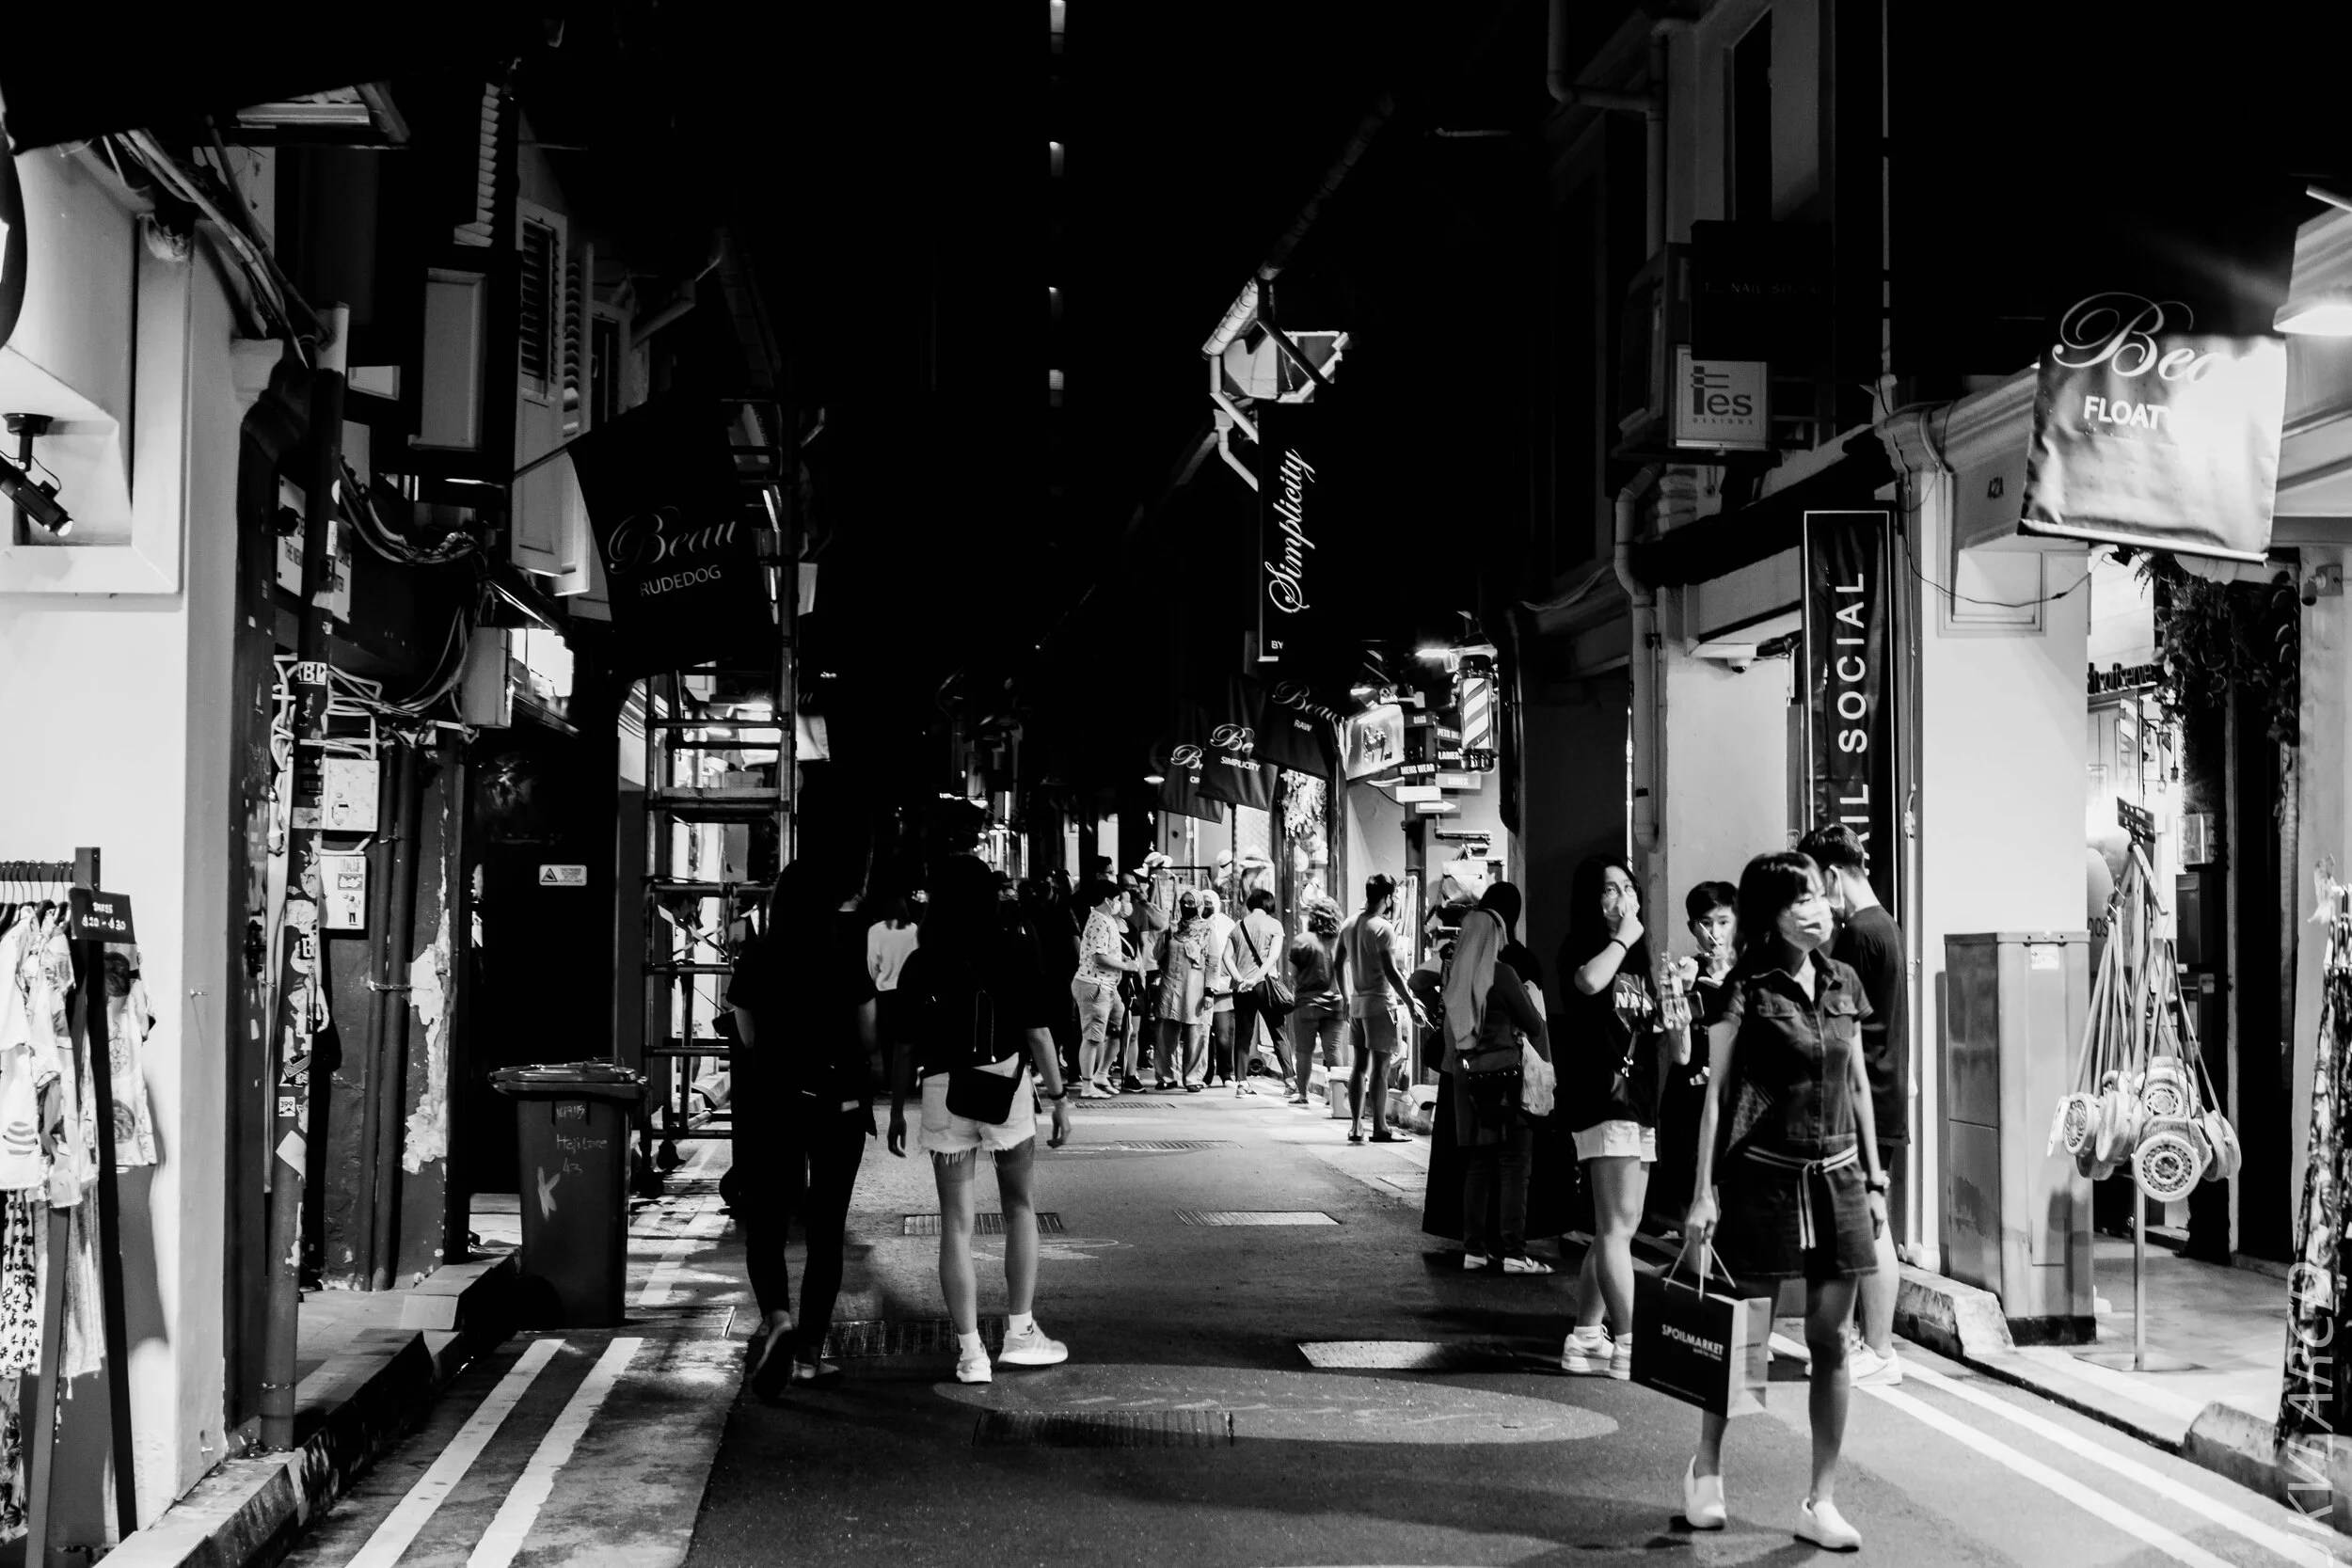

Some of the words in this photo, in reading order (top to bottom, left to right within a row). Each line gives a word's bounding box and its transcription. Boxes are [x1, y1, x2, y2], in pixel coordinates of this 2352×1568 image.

[2083, 395, 2172, 430] FLOAT
[608, 504, 737, 575] Beau
[1264, 448, 1316, 614] Simplicity
[640, 564, 723, 596] RUDEDOG
[1836, 573, 1867, 753] SOCIAL
[1294, 718, 1313, 733] RAW
[1221, 756, 1262, 772] SIMPLICITY
[1661, 1323, 1724, 1356] SPOILMARKET
